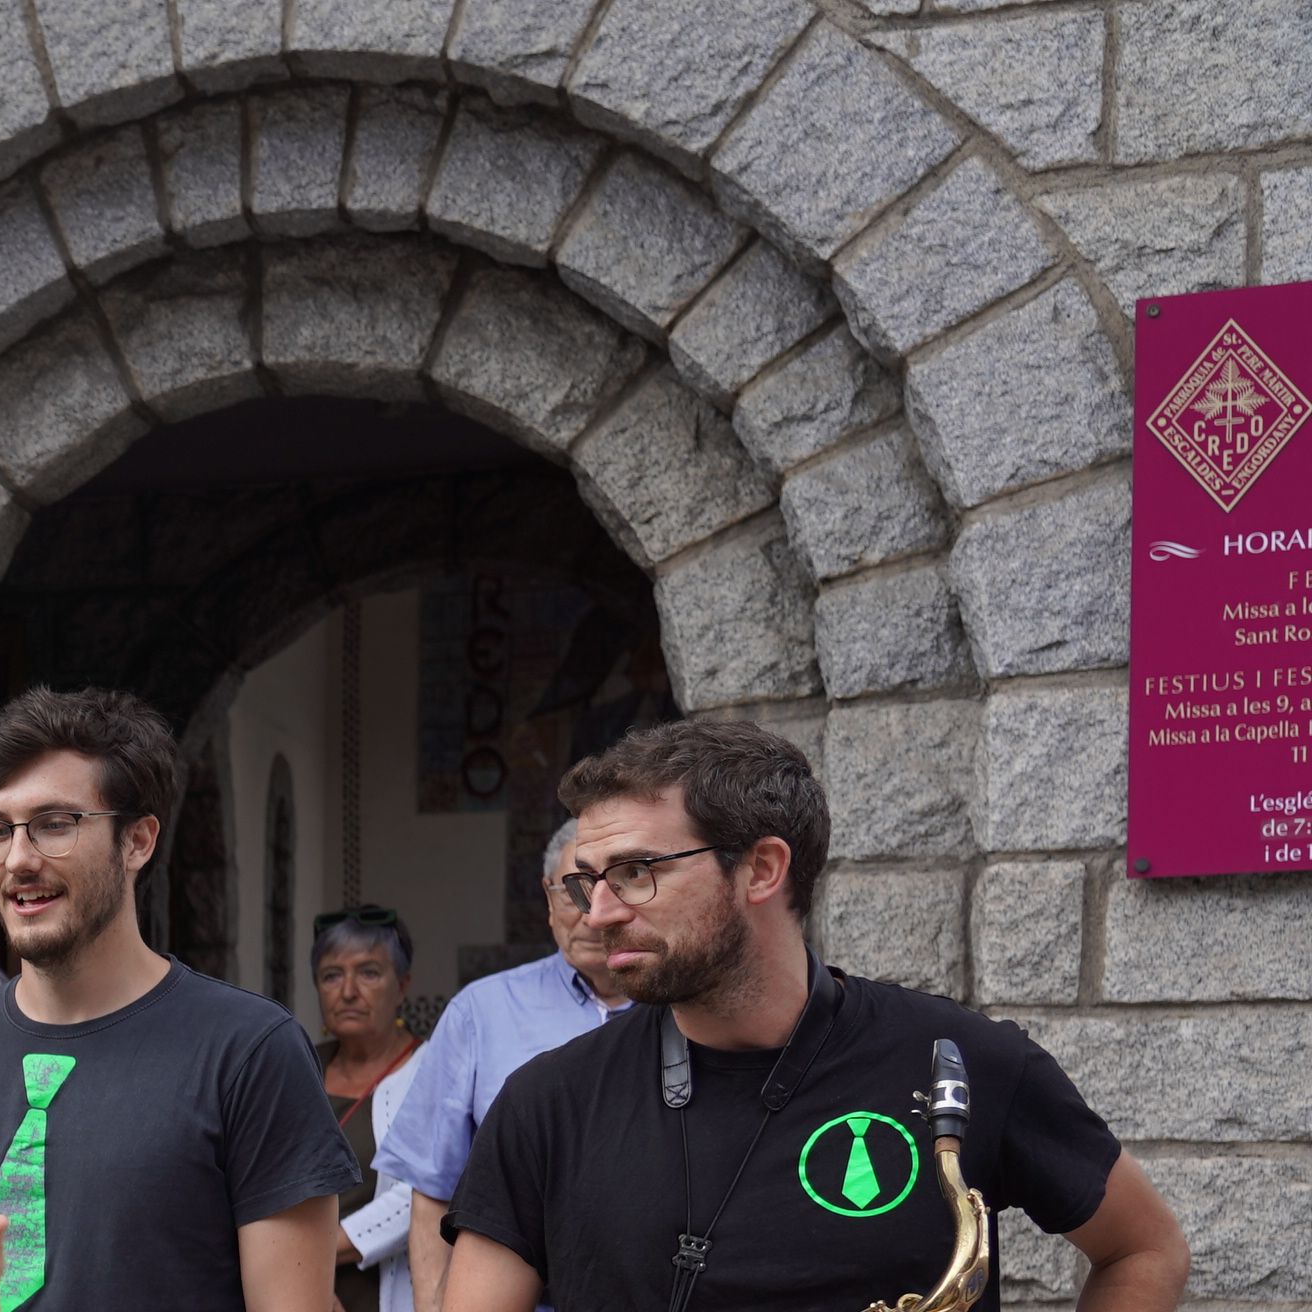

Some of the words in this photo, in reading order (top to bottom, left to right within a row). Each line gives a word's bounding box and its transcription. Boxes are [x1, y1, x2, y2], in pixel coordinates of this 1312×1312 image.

[1212, 347, 1226, 361] de
[1223, 333, 1242, 345] St.
[1237, 345, 1263, 371] PERE
[1163, 426, 1224, 490] ESCALDES
[1231, 413, 1296, 490] ENGORDANY
[1224, 528, 1312, 556] HORA
[1223, 602, 1279, 621] Missa
[1285, 602, 1296, 616] a
[1235, 627, 1279, 646] Sant
[1145, 671, 1245, 696] FESTIUS
[1256, 670, 1261, 688] I
[1273, 666, 1312, 687] FES
[1165, 701, 1221, 720] Missa
[1227, 702, 1237, 716] a
[1244, 696, 1271, 715] les
[1277, 695, 1294, 715] 9,
[1149, 728, 1196, 747] Missa
[1201, 729, 1210, 743] a
[1216, 724, 1230, 742] la
[1235, 720, 1299, 744] Capella
[1291, 745, 1307, 764] 11
[1262, 818, 1288, 837] de
[1265, 845, 1269, 863] i
[1275, 843, 1302, 862] de
